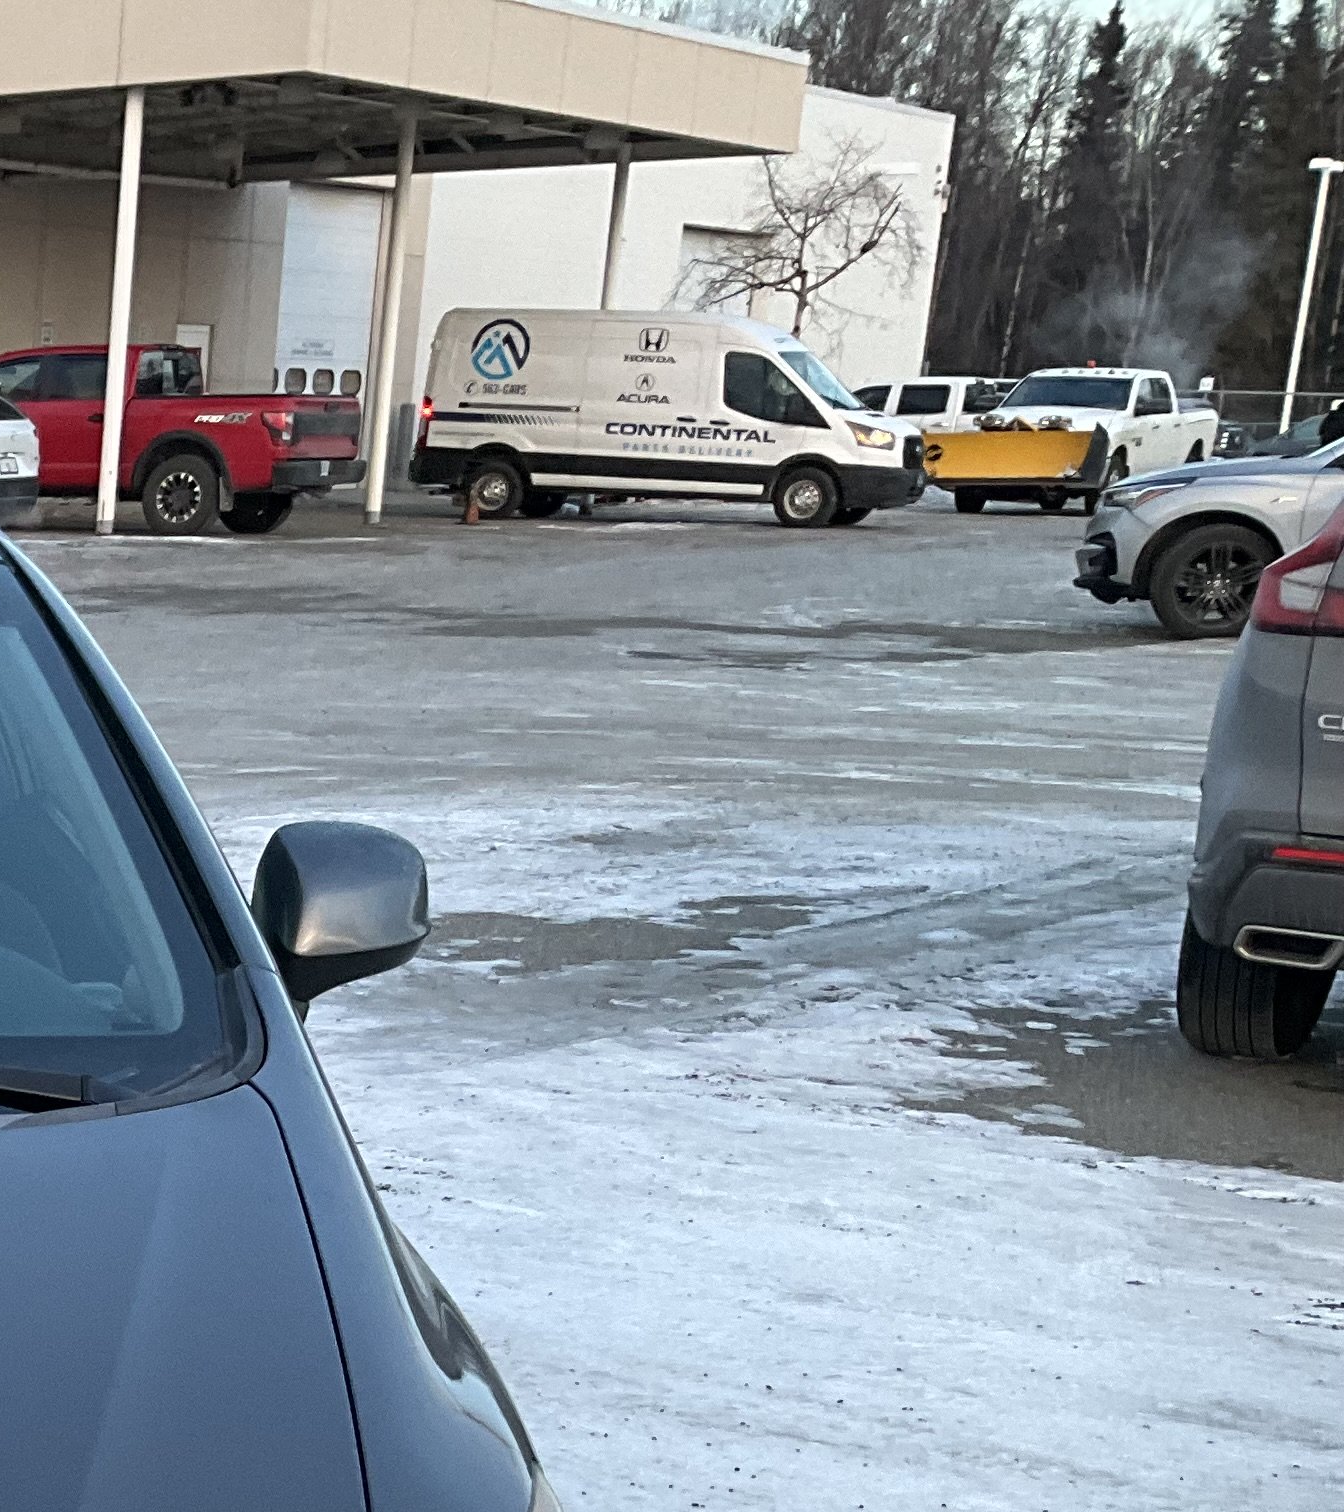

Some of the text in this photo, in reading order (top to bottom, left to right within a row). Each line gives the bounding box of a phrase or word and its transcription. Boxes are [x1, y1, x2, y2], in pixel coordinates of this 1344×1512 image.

[623, 354, 676, 364] HONDA
[616, 393, 671, 404] ACURA
[605, 422, 776, 444] CONTINENTAL
[1318, 714, 1344, 730] C
